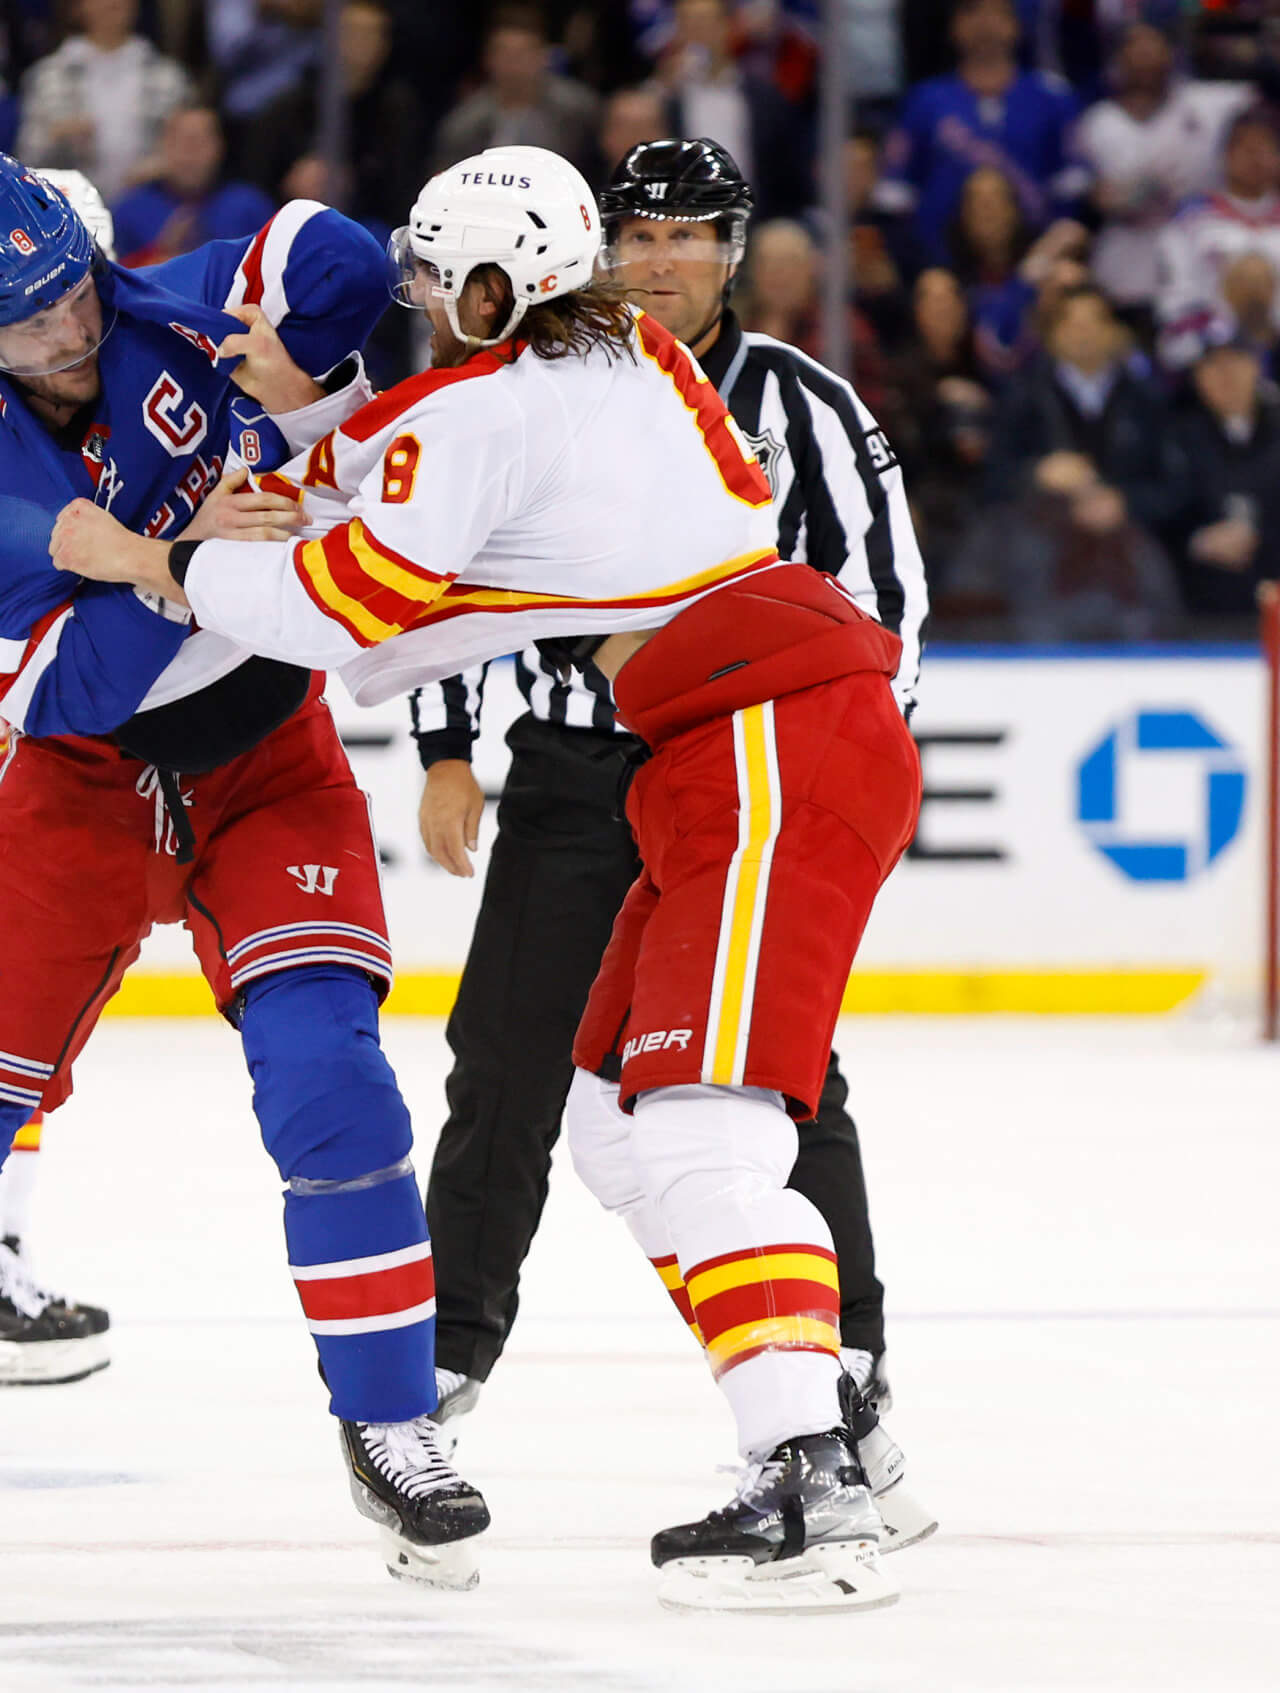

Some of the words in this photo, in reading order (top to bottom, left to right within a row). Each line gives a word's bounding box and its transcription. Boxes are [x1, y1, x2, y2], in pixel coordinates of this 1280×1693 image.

[461, 173, 532, 189] TELUS
[579, 204, 591, 232] 8
[9, 228, 38, 256] 8
[24, 262, 66, 296] BAUER
[142, 369, 208, 458] C
[239, 430, 261, 465] 8
[303, 429, 342, 493] A
[381, 432, 423, 504] 8
